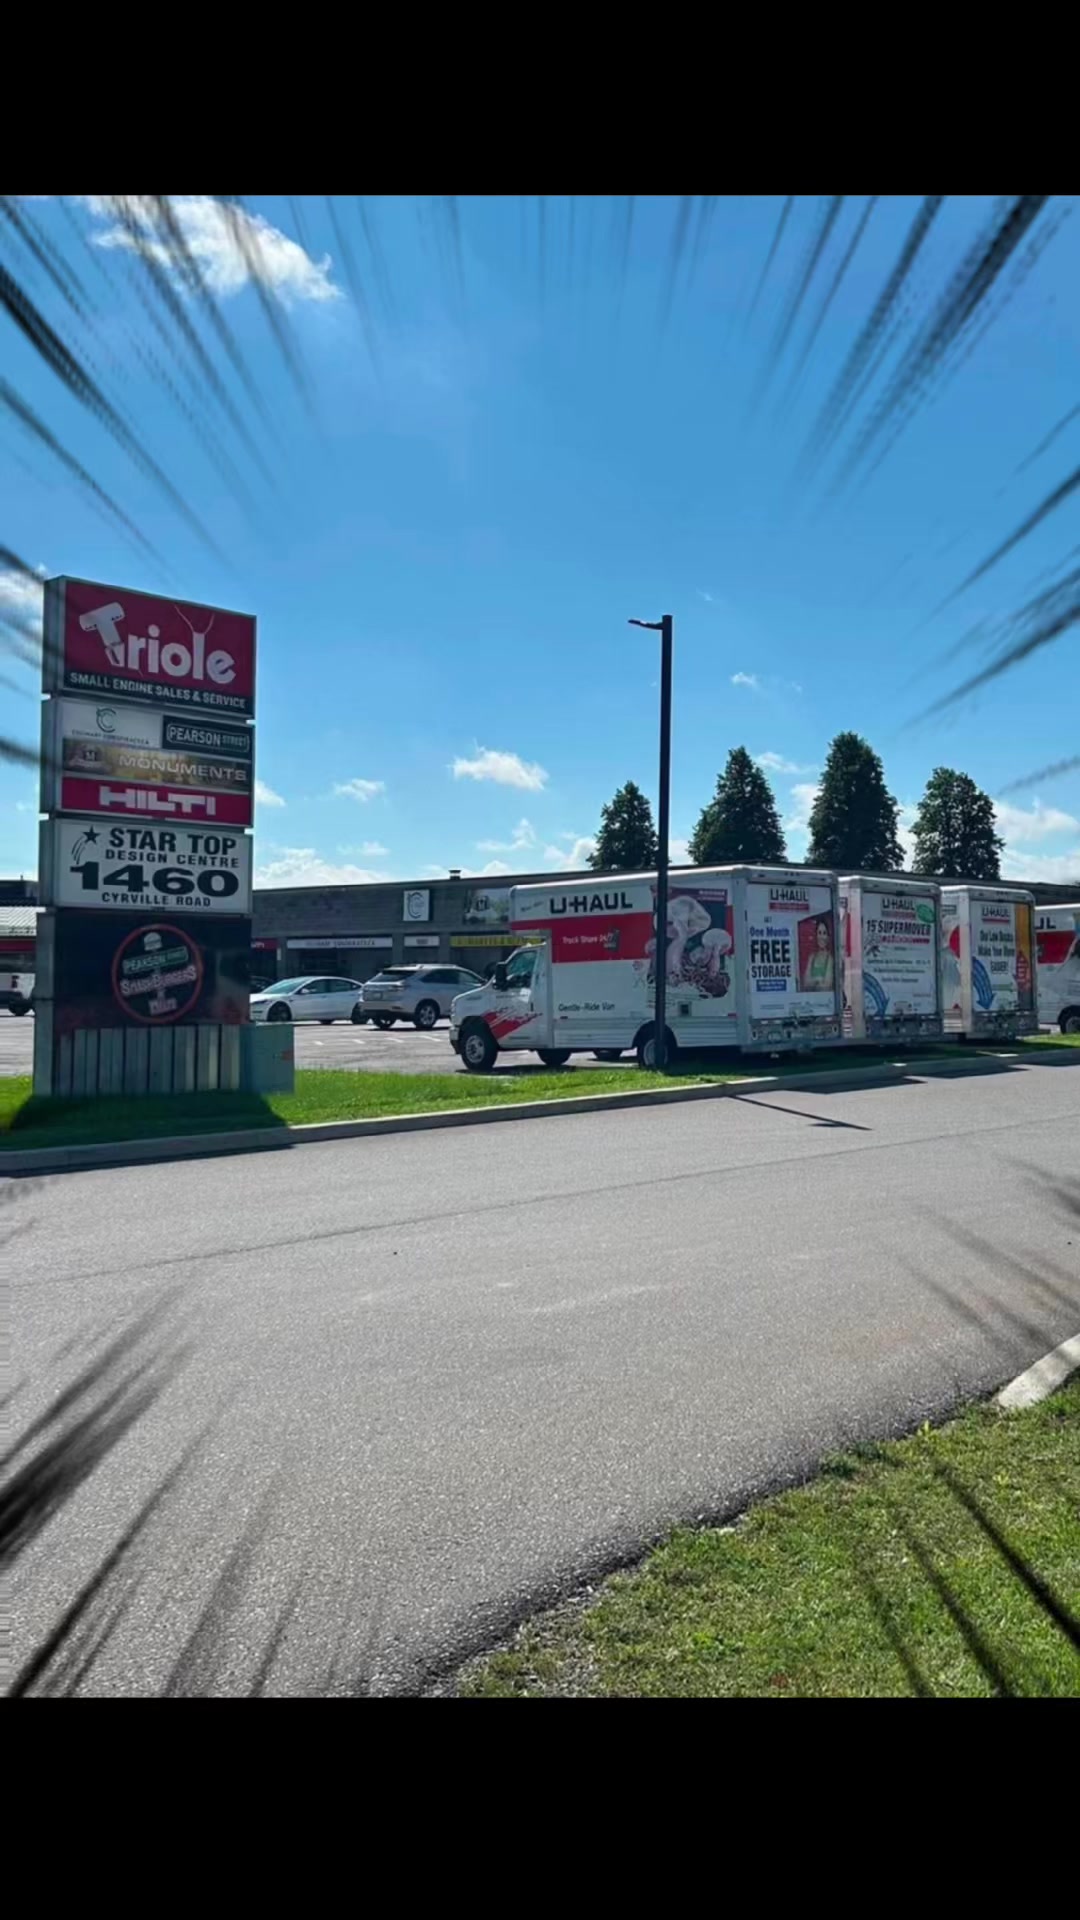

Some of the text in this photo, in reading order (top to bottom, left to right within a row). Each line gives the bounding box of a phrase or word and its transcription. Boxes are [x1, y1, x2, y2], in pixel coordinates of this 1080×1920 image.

[79, 601, 236, 684] Triole
[70, 671, 245, 709] SMALL ENGINE SALES & SERVICE
[169, 726, 247, 747] PEARSON STREET
[119, 755, 248, 781] MONUMENTS
[99, 785, 216, 816] HILTI
[109, 827, 237, 856] STAR TOP
[105, 849, 239, 869] DESIGN CENTRE
[70, 861, 239, 897] 1460
[102, 892, 211, 907] CYRVILLE ROAD
[550, 892, 633, 914] U-HAUL
[770, 888, 809, 901] U-HAUL
[751, 940, 791, 963] FREE
[751, 965, 792, 978] STORAGE
